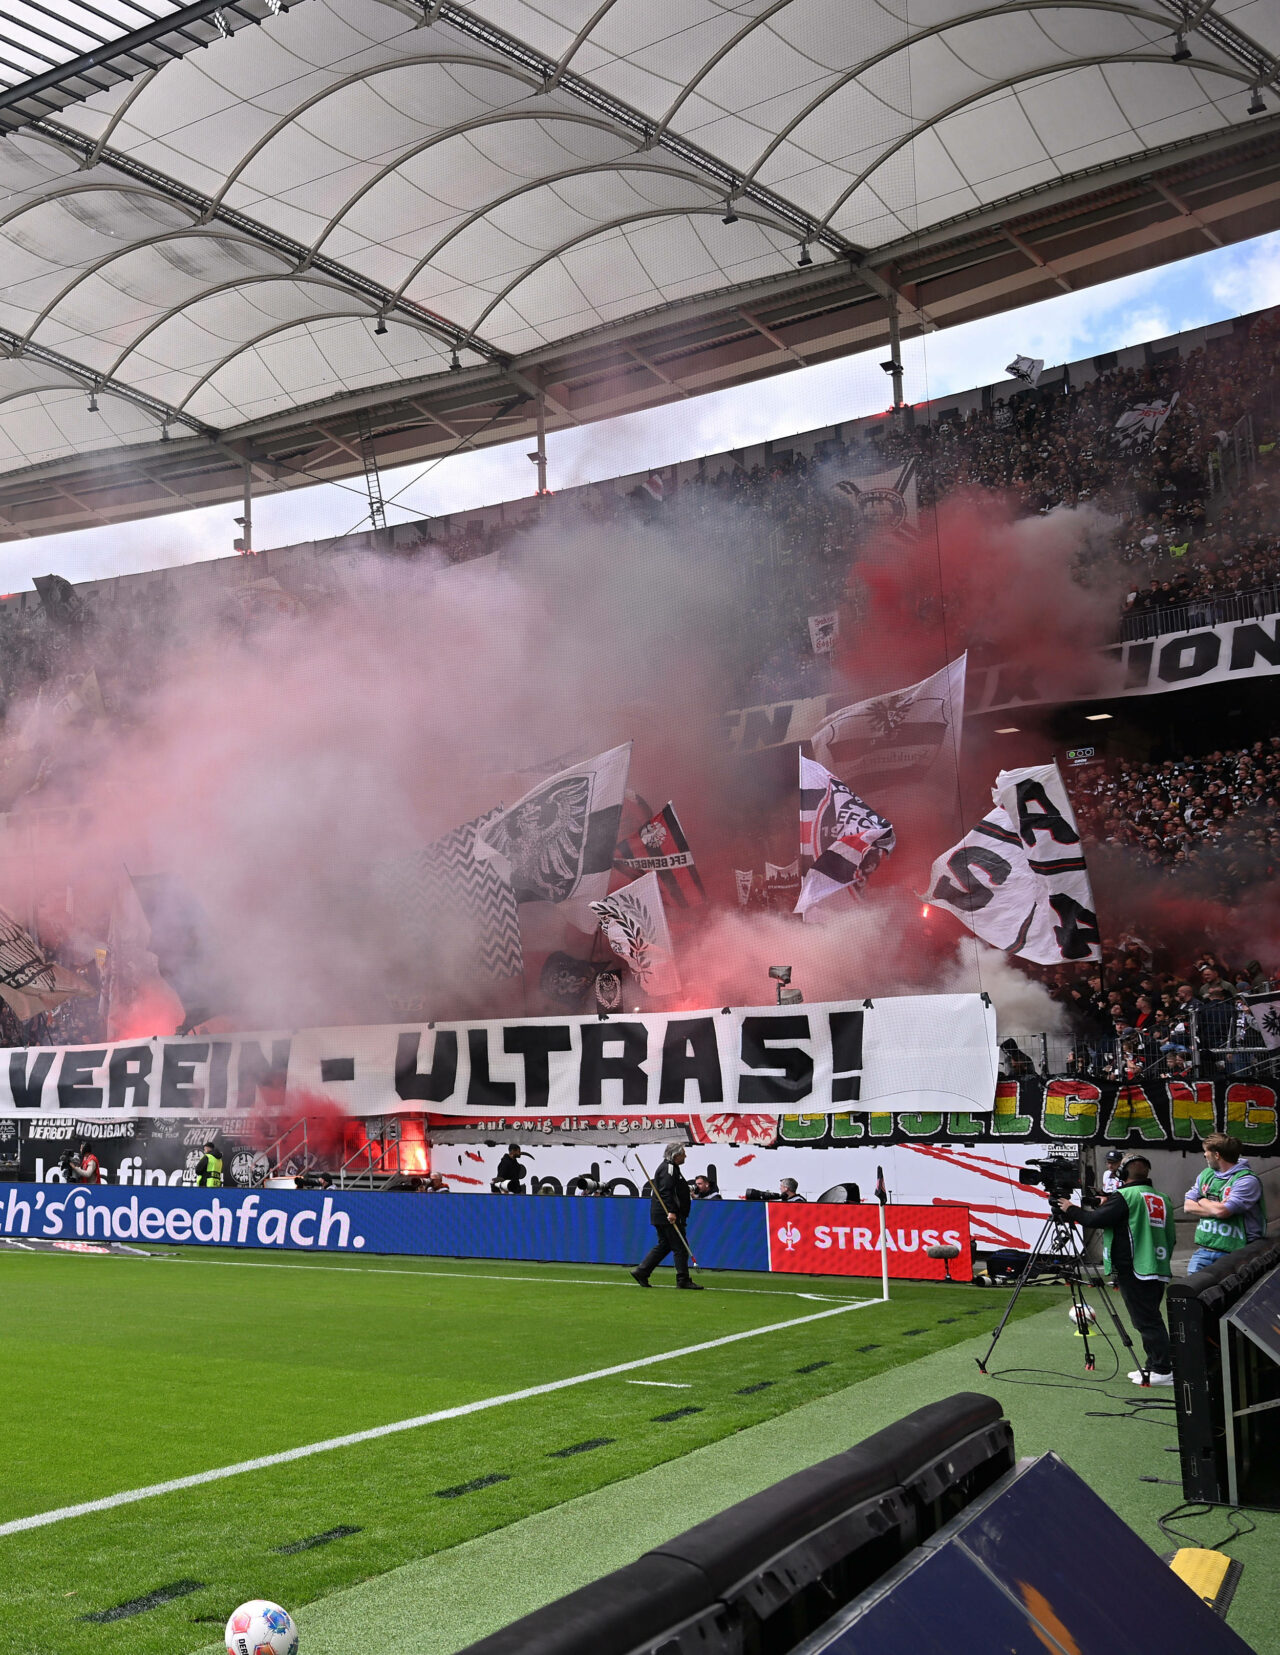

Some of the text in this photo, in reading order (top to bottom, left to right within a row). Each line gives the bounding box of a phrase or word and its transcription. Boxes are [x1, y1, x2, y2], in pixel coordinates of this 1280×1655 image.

[9, 1039, 291, 1109] VEREIN
[321, 1057, 355, 1082] -
[395, 1010, 864, 1107] ULTRAS!
[28, 1126, 74, 1140] VERBOT
[76, 1121, 135, 1138] HOOLIGANS
[477, 1115, 677, 1135] auf ewig dir ergeben
[814, 1225, 963, 1252] STRAUSS
